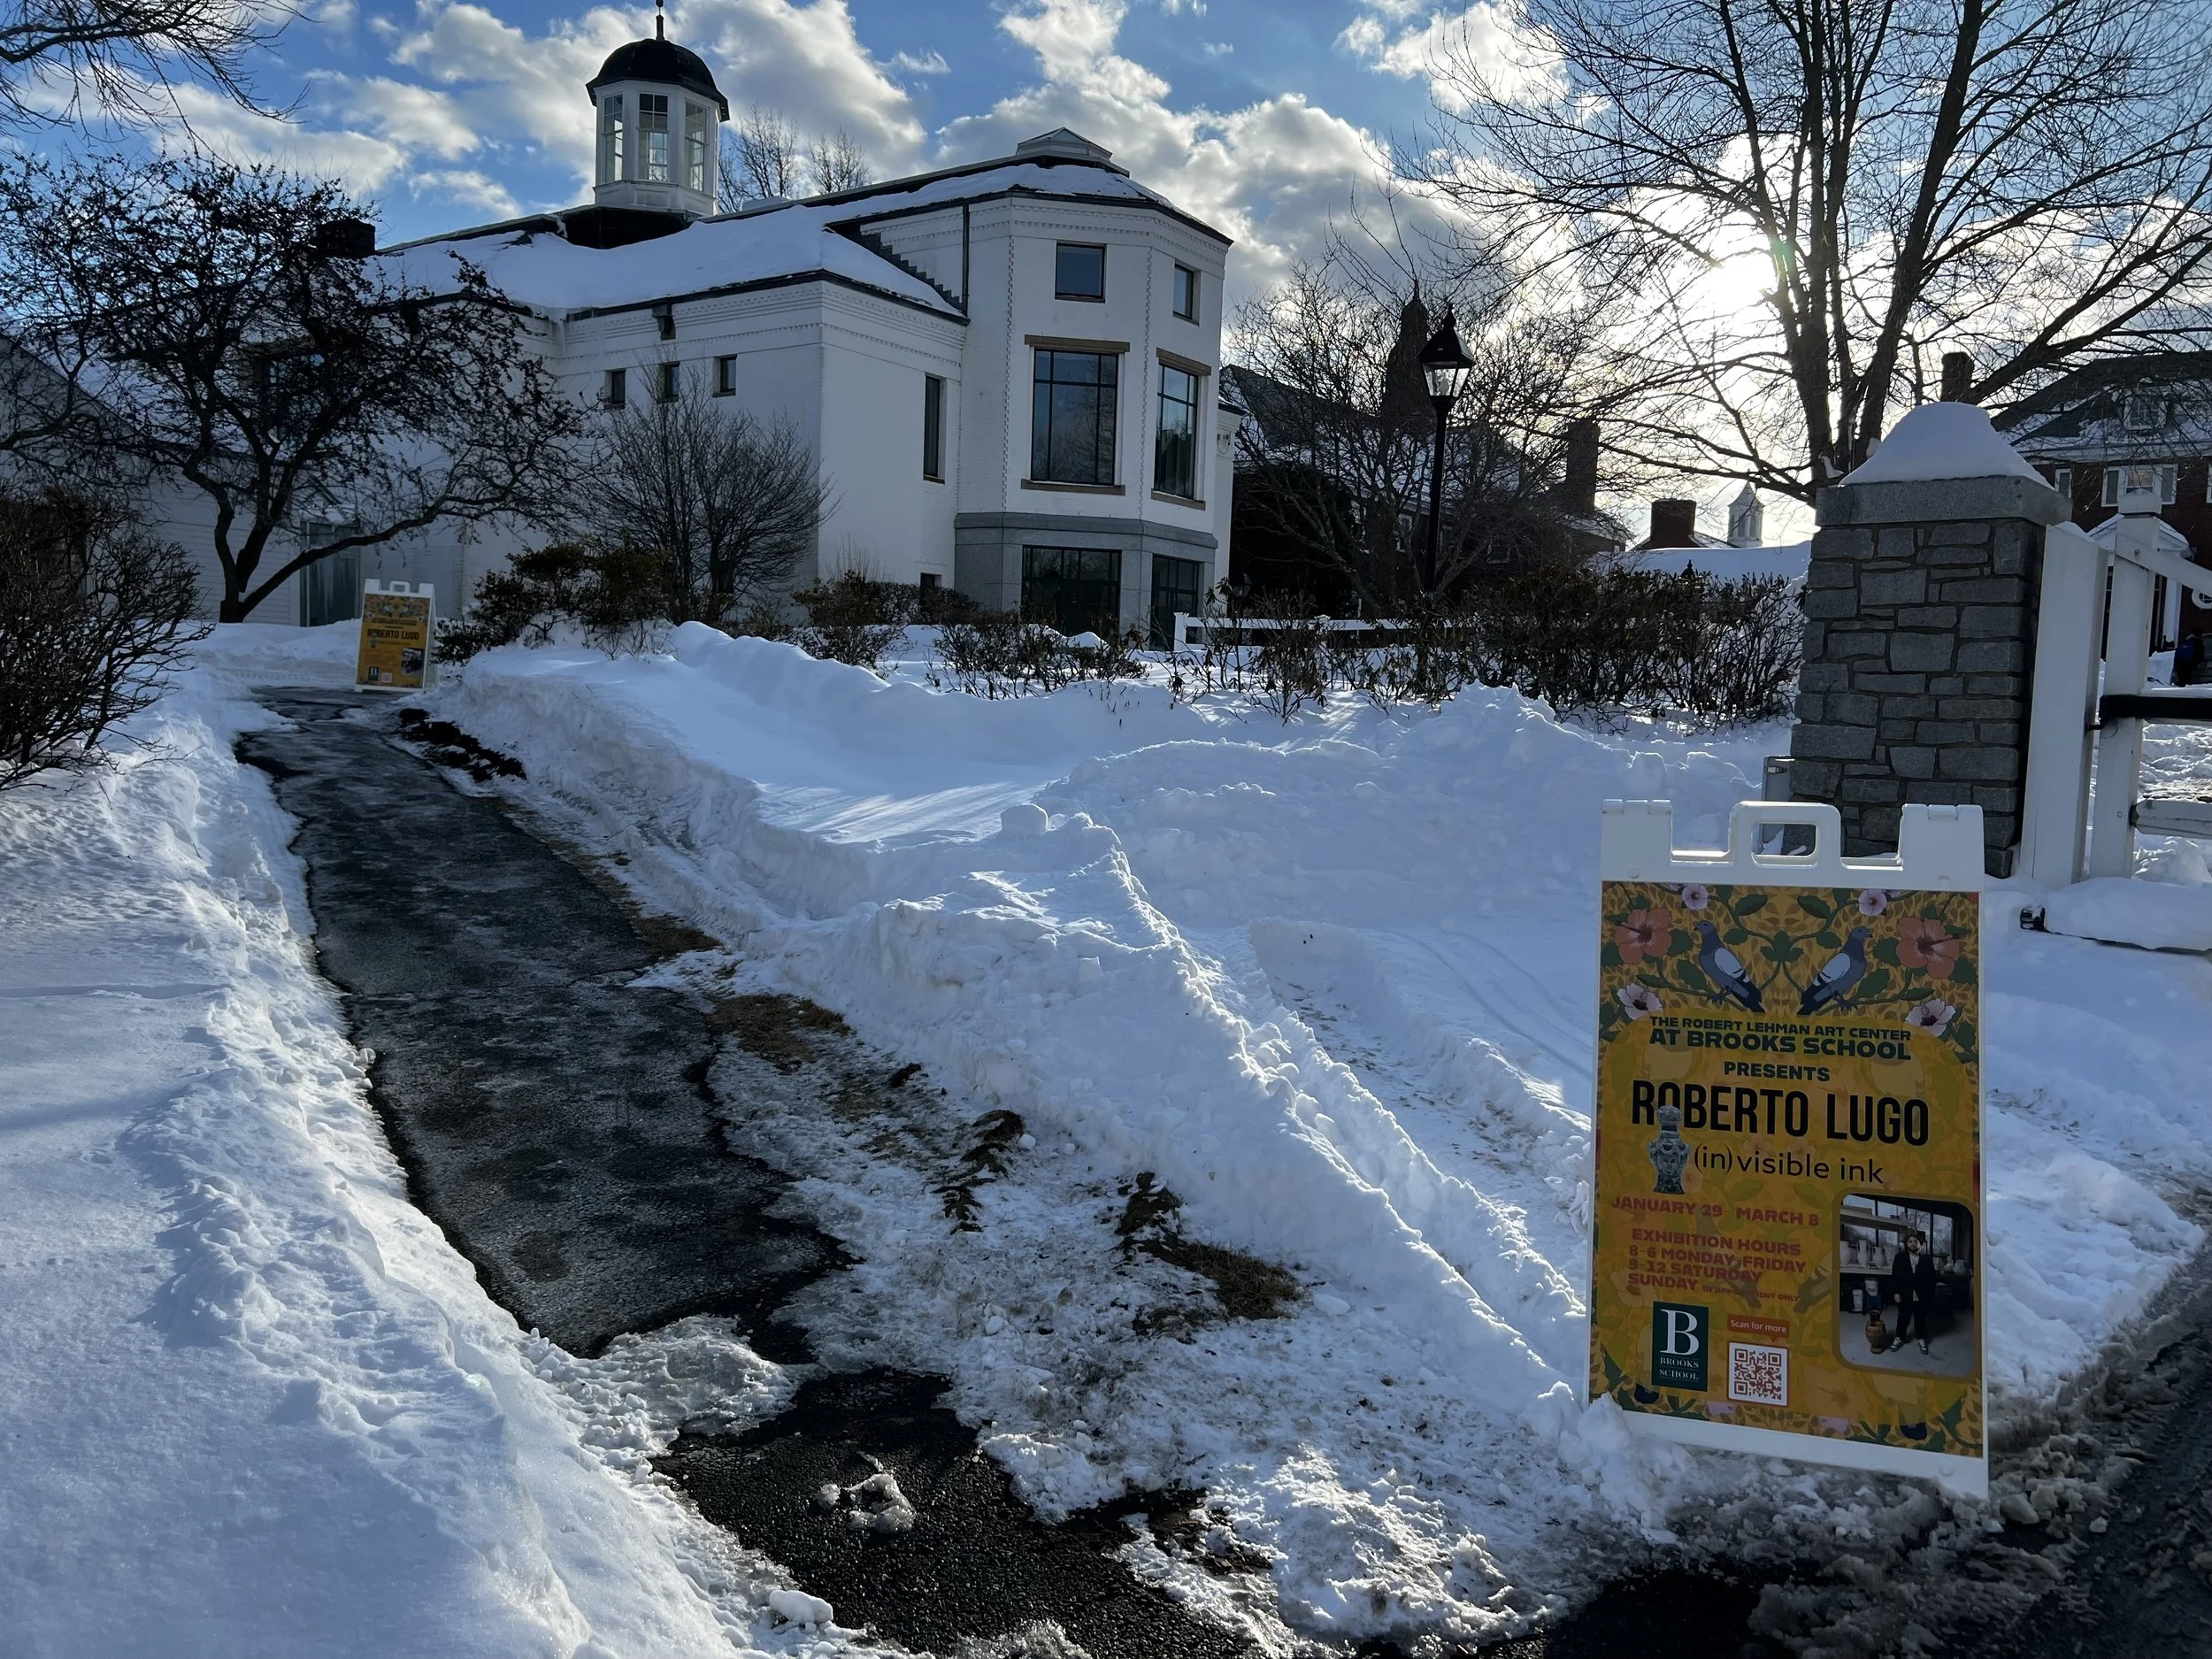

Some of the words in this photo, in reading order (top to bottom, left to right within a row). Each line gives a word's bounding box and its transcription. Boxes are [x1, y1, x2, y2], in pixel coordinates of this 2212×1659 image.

[1649, 1016, 1679, 1028] THE
[1682, 1018, 1743, 1032] ROBERT
[1747, 1021, 1811, 1035] LEHMAN
[1814, 1025, 1845, 1037] ART
[1848, 1027, 1912, 1041] CENTER
[1649, 1027, 1681, 1046] AT
[1686, 1030, 1797, 1054] BROOKS
[1802, 1036, 1912, 1061] SCHOOL
[1724, 1061, 1831, 1082] PRESENTS
[1632, 1079, 1809, 1138] ROBERTO
[1826, 1093, 1930, 1147] LUGO
[1839, 1157, 1884, 1184] ink
[1611, 1195, 1698, 1216] JANUARY
[1736, 1206, 1803, 1225] MARCH
[1808, 1214, 1820, 1226] 8
[1632, 1227, 1733, 1249] EXHIBITION
[1737, 1239, 1801, 1256] HOURS
[1671, 1262, 1763, 1282] SATURDAY
[1628, 1272, 1698, 1292] SUNDAY
[1778, 1294, 1800, 1302] ONLY
[1659, 1309, 1700, 1356] B
[1730, 1319, 1750, 1328] Scan
[1752, 1321, 1763, 1330] for
[1764, 1325, 1786, 1333] more
[1659, 1368, 1700, 1381] SCHOOL
[1660, 1356, 1700, 1369] BROOKS
